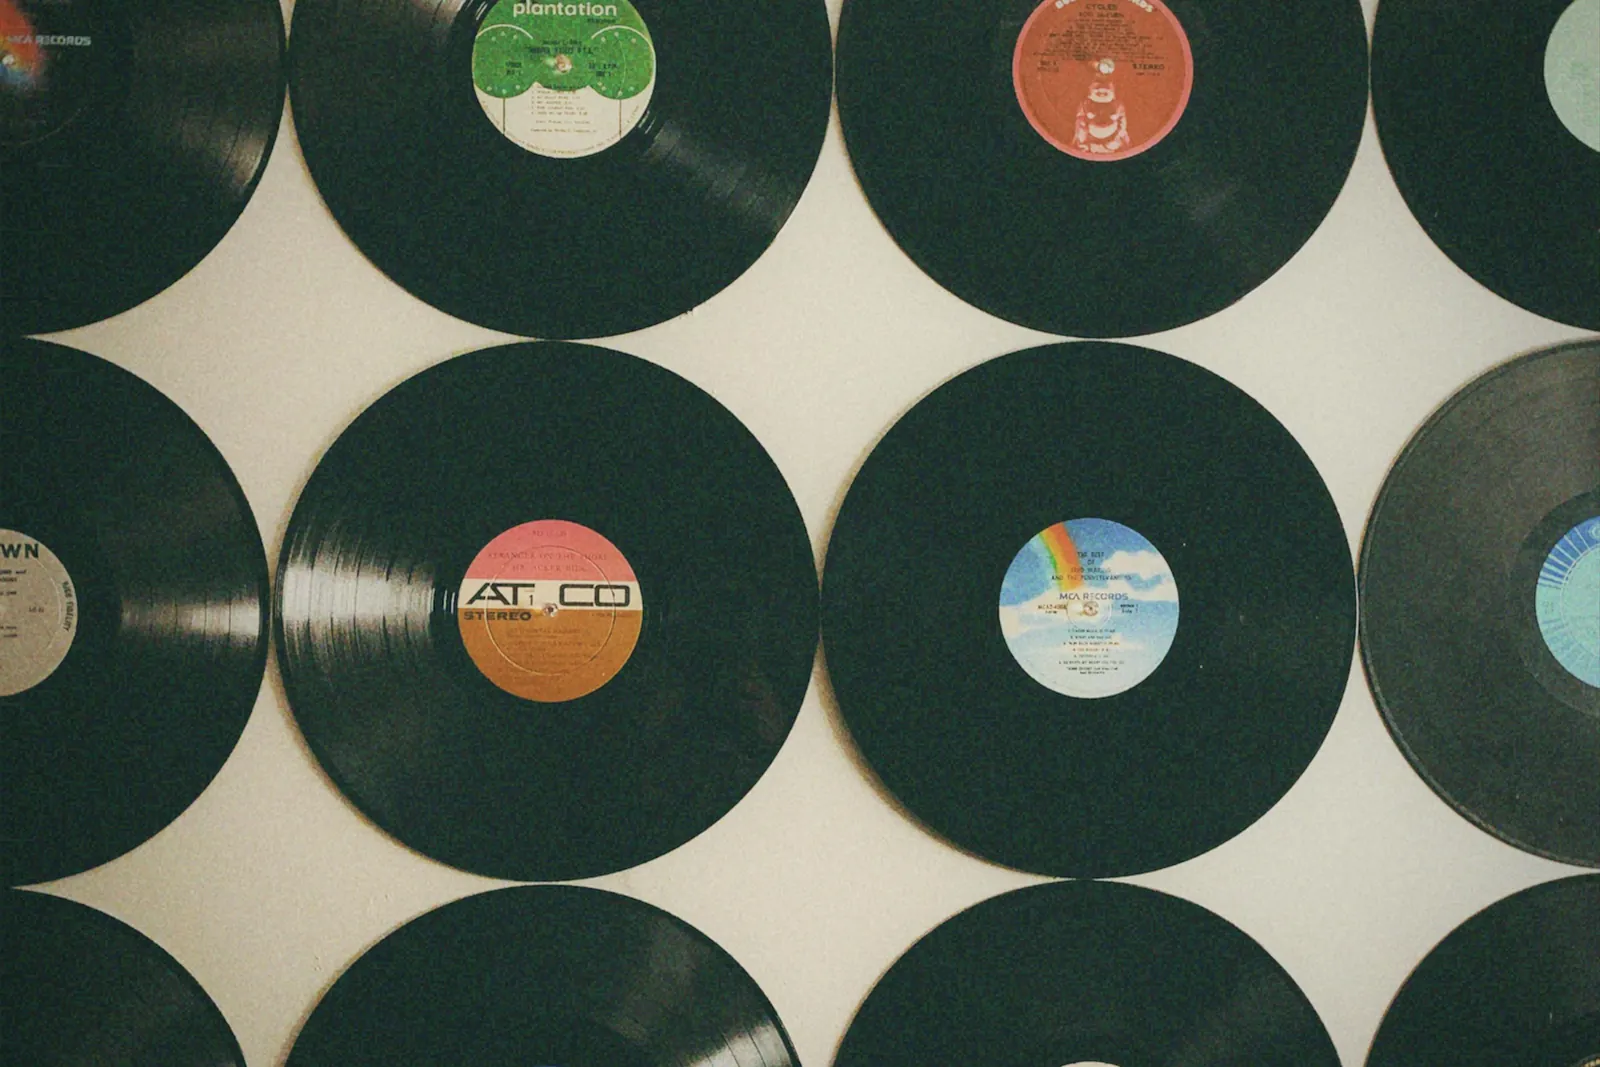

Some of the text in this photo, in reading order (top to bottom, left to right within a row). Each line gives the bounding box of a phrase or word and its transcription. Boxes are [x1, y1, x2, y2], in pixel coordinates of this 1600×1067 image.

[513, 0, 617, 17] plantation
[35, 34, 92, 46] RECORDS
[1059, 592, 1129, 601] MCA RECORDS
[464, 610, 532, 621] STEREO
